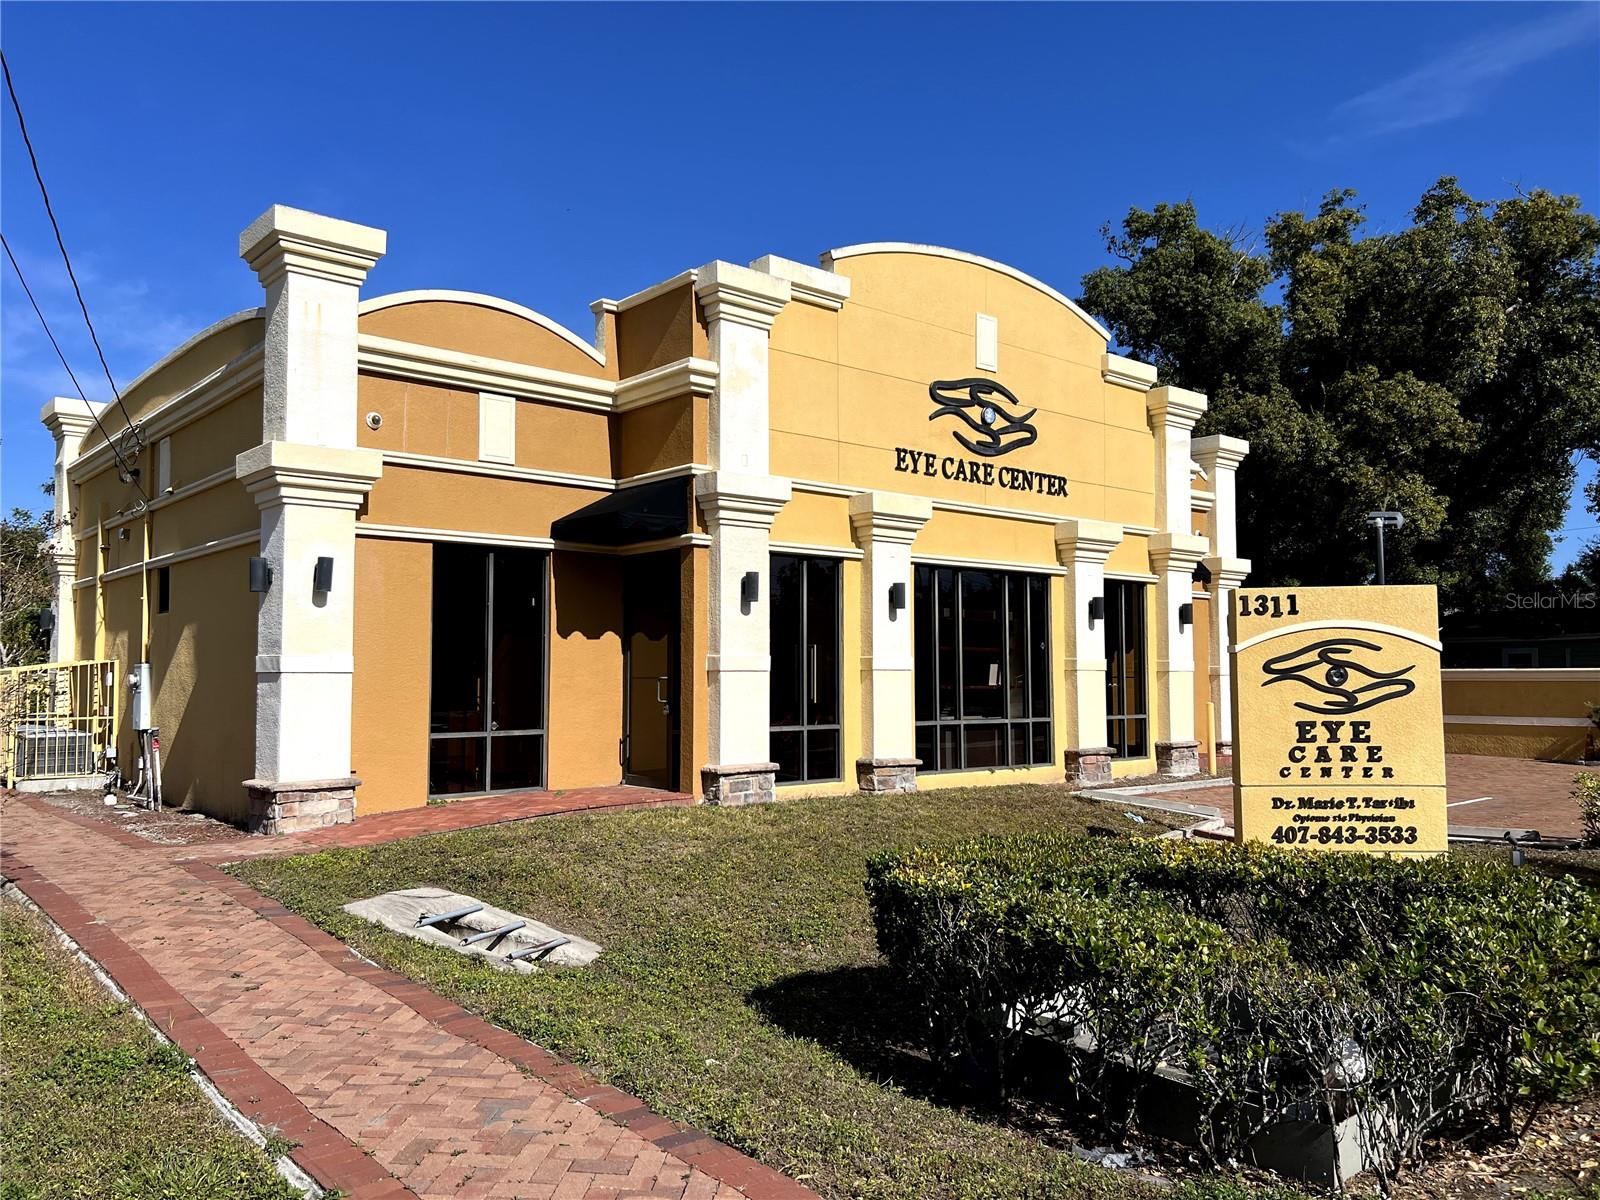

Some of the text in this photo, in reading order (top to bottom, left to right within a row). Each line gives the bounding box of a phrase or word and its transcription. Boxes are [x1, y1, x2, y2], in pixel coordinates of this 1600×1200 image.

[894, 447, 1069, 498] EYE CARE CENTER
[1239, 594, 1300, 618] 1311
[1295, 720, 1371, 744] EYE
[1287, 745, 1383, 763] CARE
[1279, 766, 1395, 778] CENTER
[1271, 797, 1296, 809] Dr.
[1297, 797, 1345, 809] Marie
[1345, 797, 1361, 809] T.
[1348, 813, 1396, 824] Physician
[1271, 826, 1418, 844] 407-843-3533
